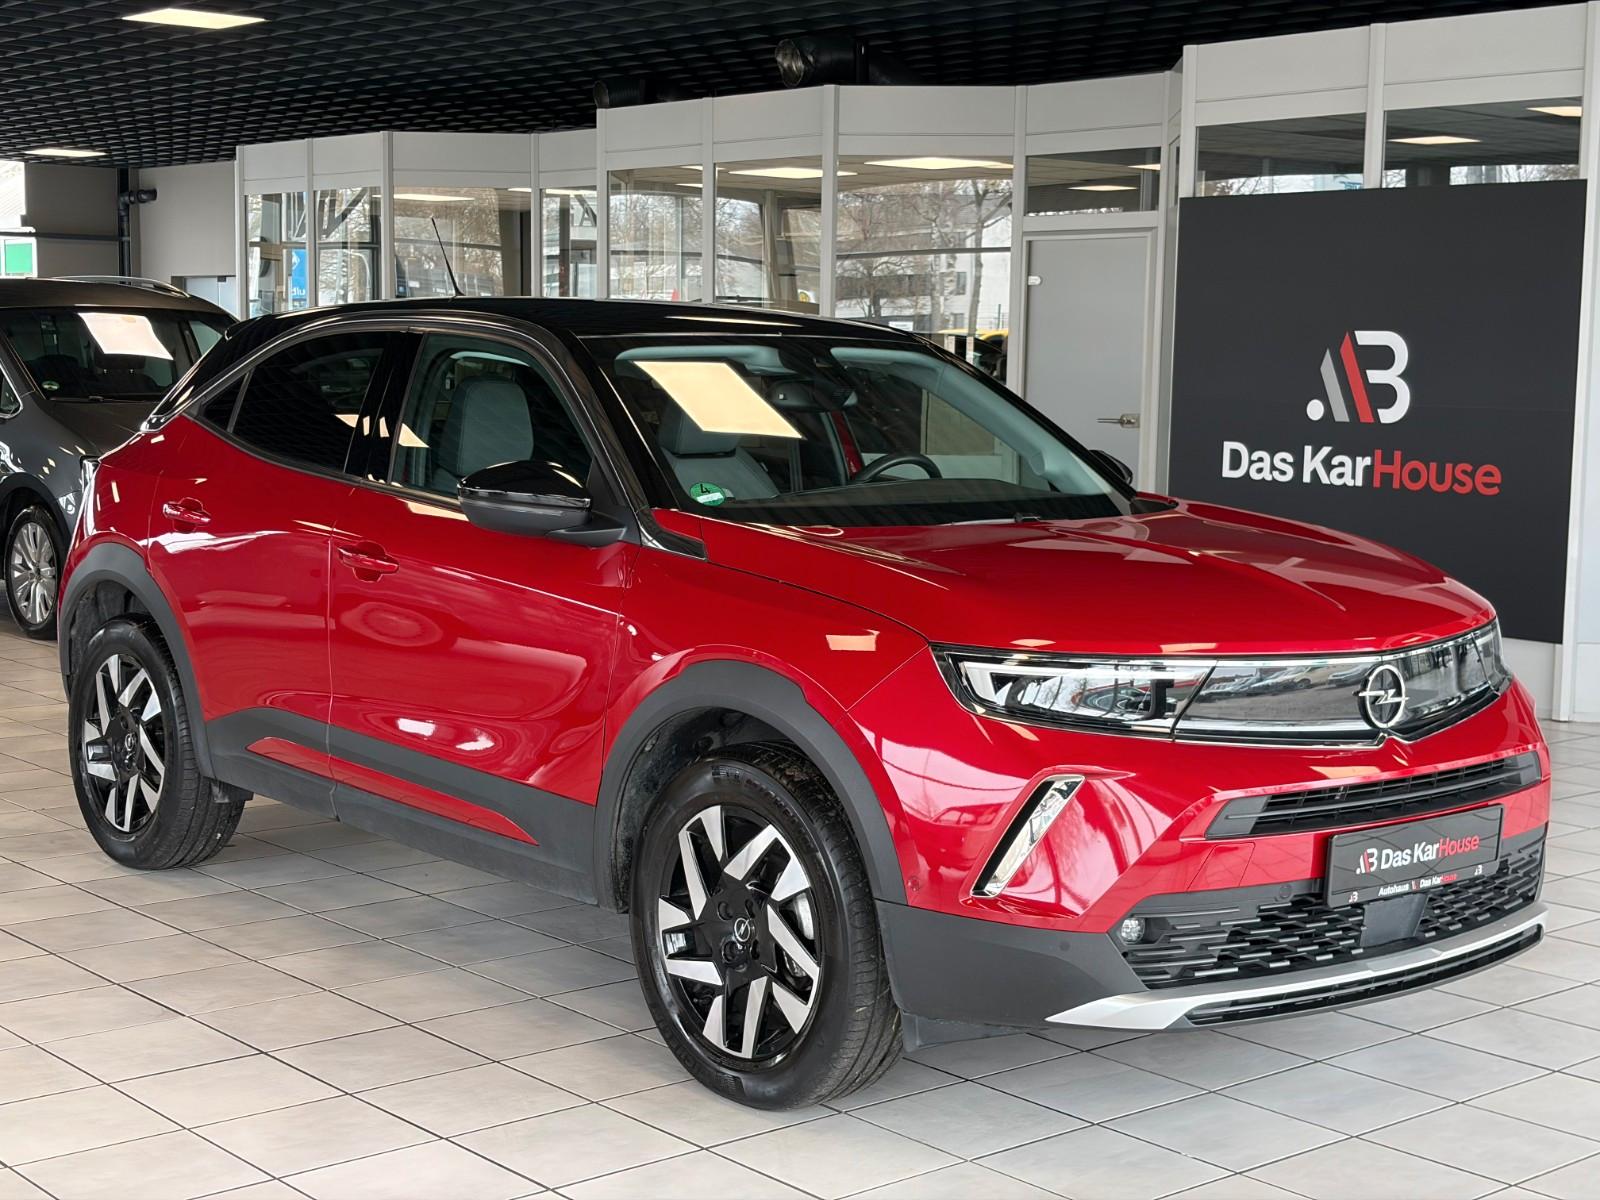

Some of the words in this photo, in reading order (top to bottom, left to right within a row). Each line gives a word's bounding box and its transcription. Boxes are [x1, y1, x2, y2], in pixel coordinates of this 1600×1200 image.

[1221, 440, 1294, 482] Das
[1302, 444, 1502, 495] KarHouse
[1380, 848, 1411, 870] Das
[1412, 834, 1480, 864] KarHouse
[1377, 883, 1409, 897] Autohaus
